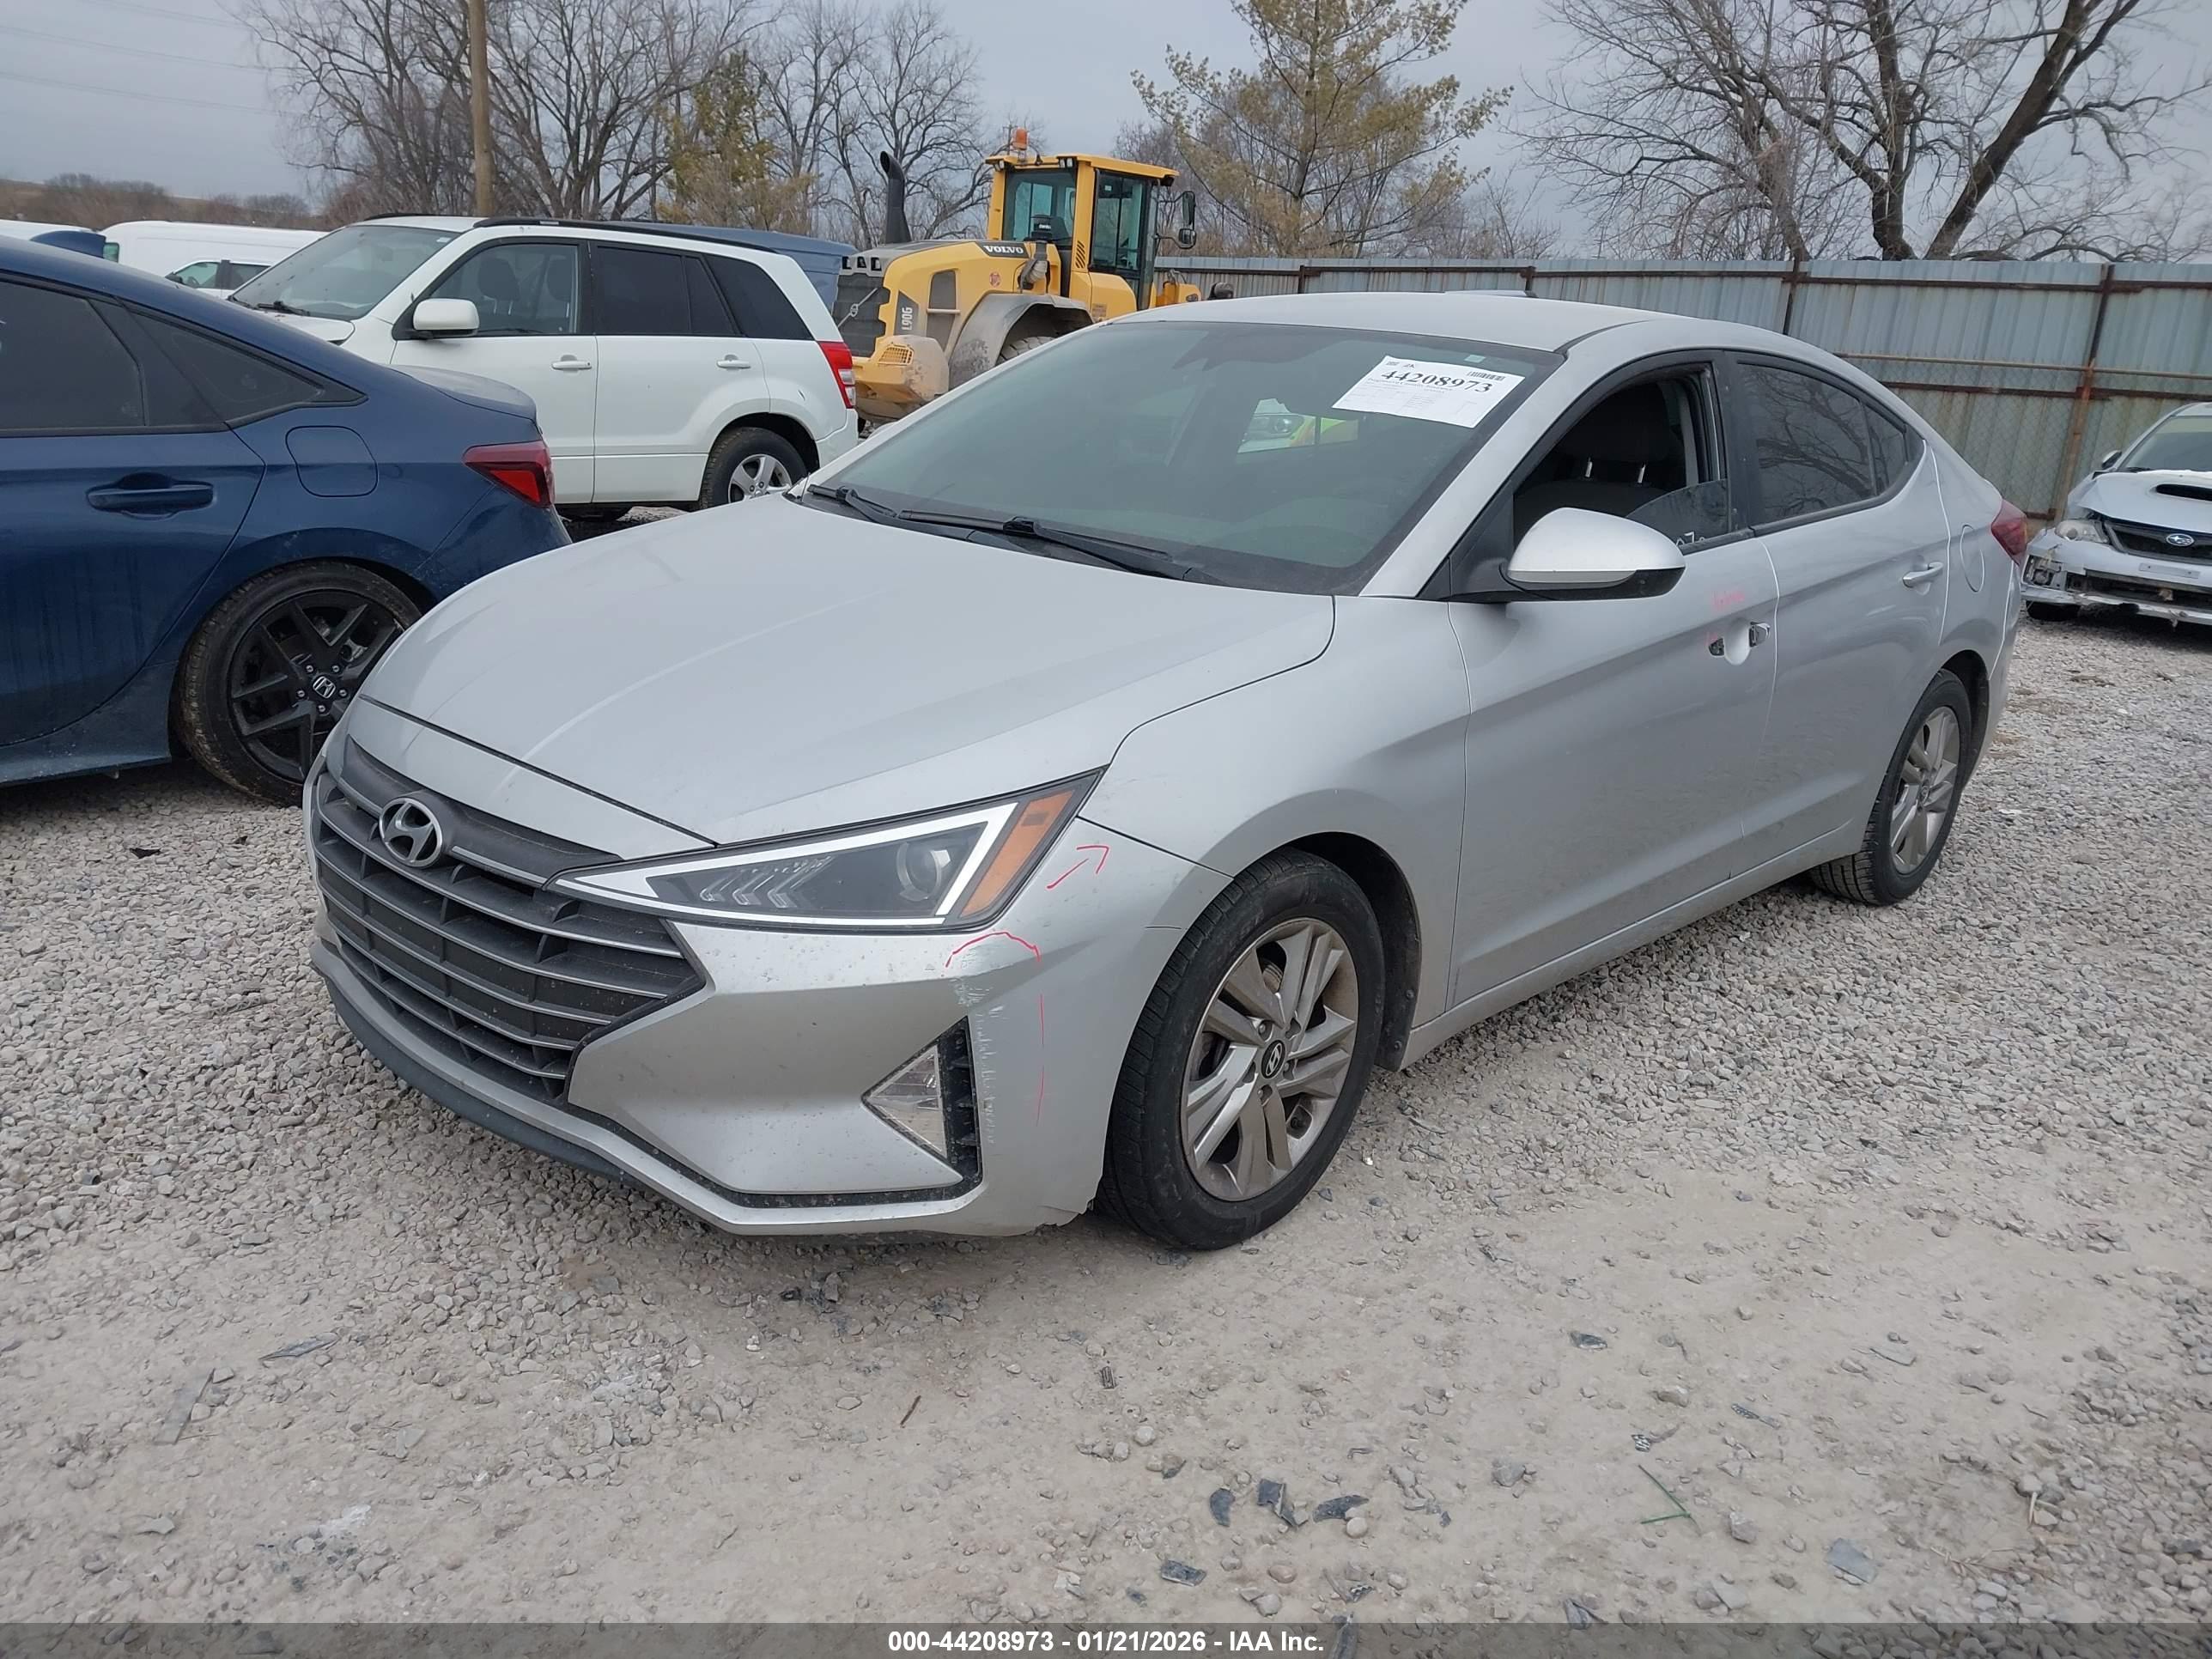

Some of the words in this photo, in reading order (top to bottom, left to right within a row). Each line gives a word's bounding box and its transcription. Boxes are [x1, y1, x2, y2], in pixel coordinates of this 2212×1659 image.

[983, 245, 1024, 254] VOLVO
[901, 307, 913, 331] L90G
[1381, 370, 1492, 392] 44208973
